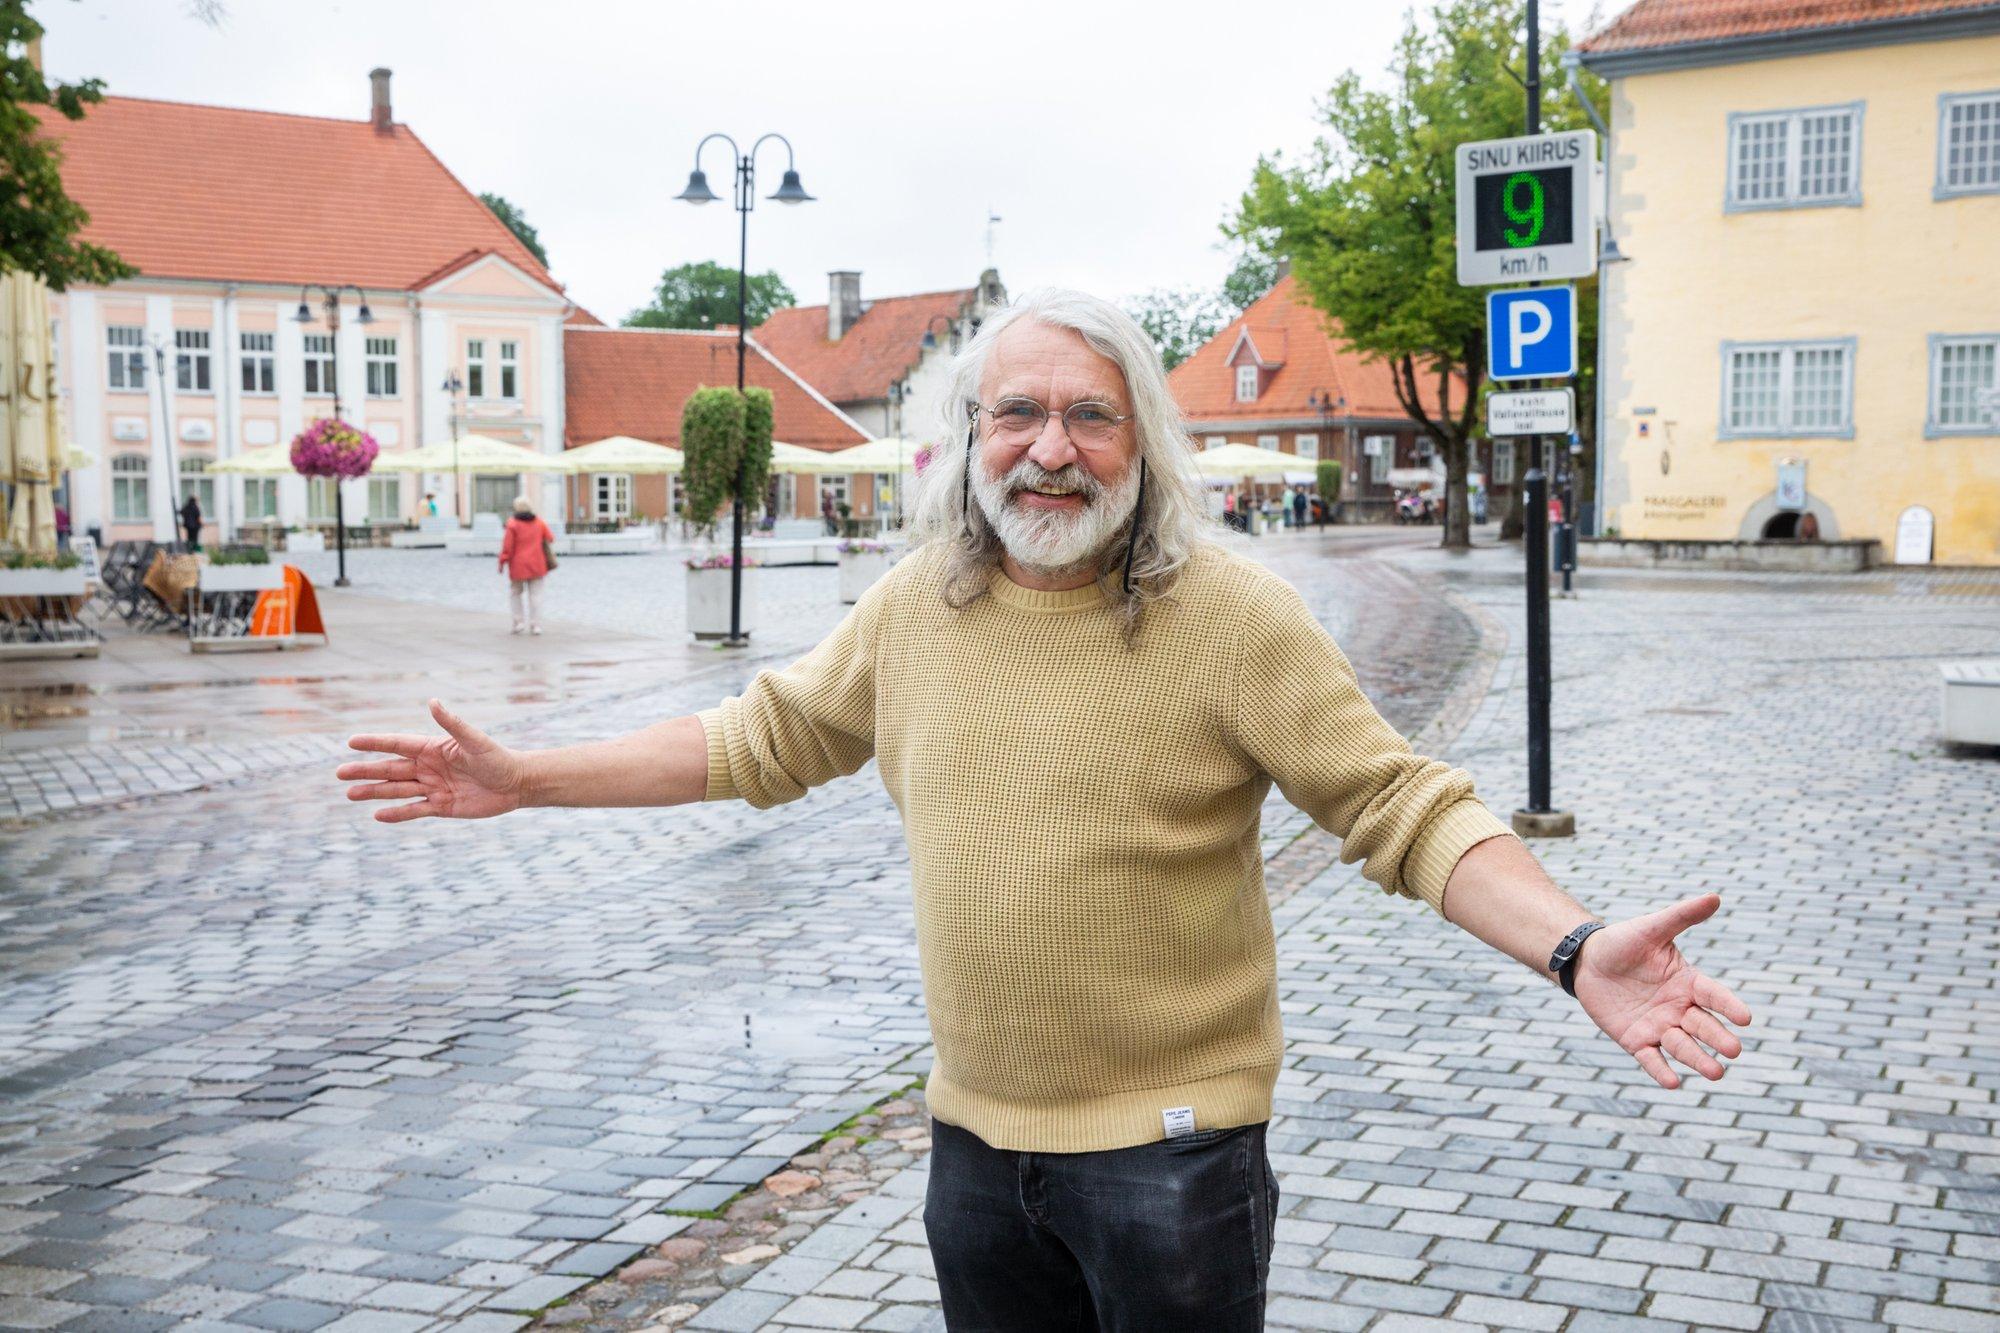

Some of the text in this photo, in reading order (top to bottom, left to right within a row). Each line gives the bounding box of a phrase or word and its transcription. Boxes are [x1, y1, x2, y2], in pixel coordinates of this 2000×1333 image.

[1468, 138, 1580, 170] SINU KIIRUS
[1504, 172, 1544, 248] 9
[1501, 253, 1548, 274] km/h
[1509, 299, 1552, 368] P
